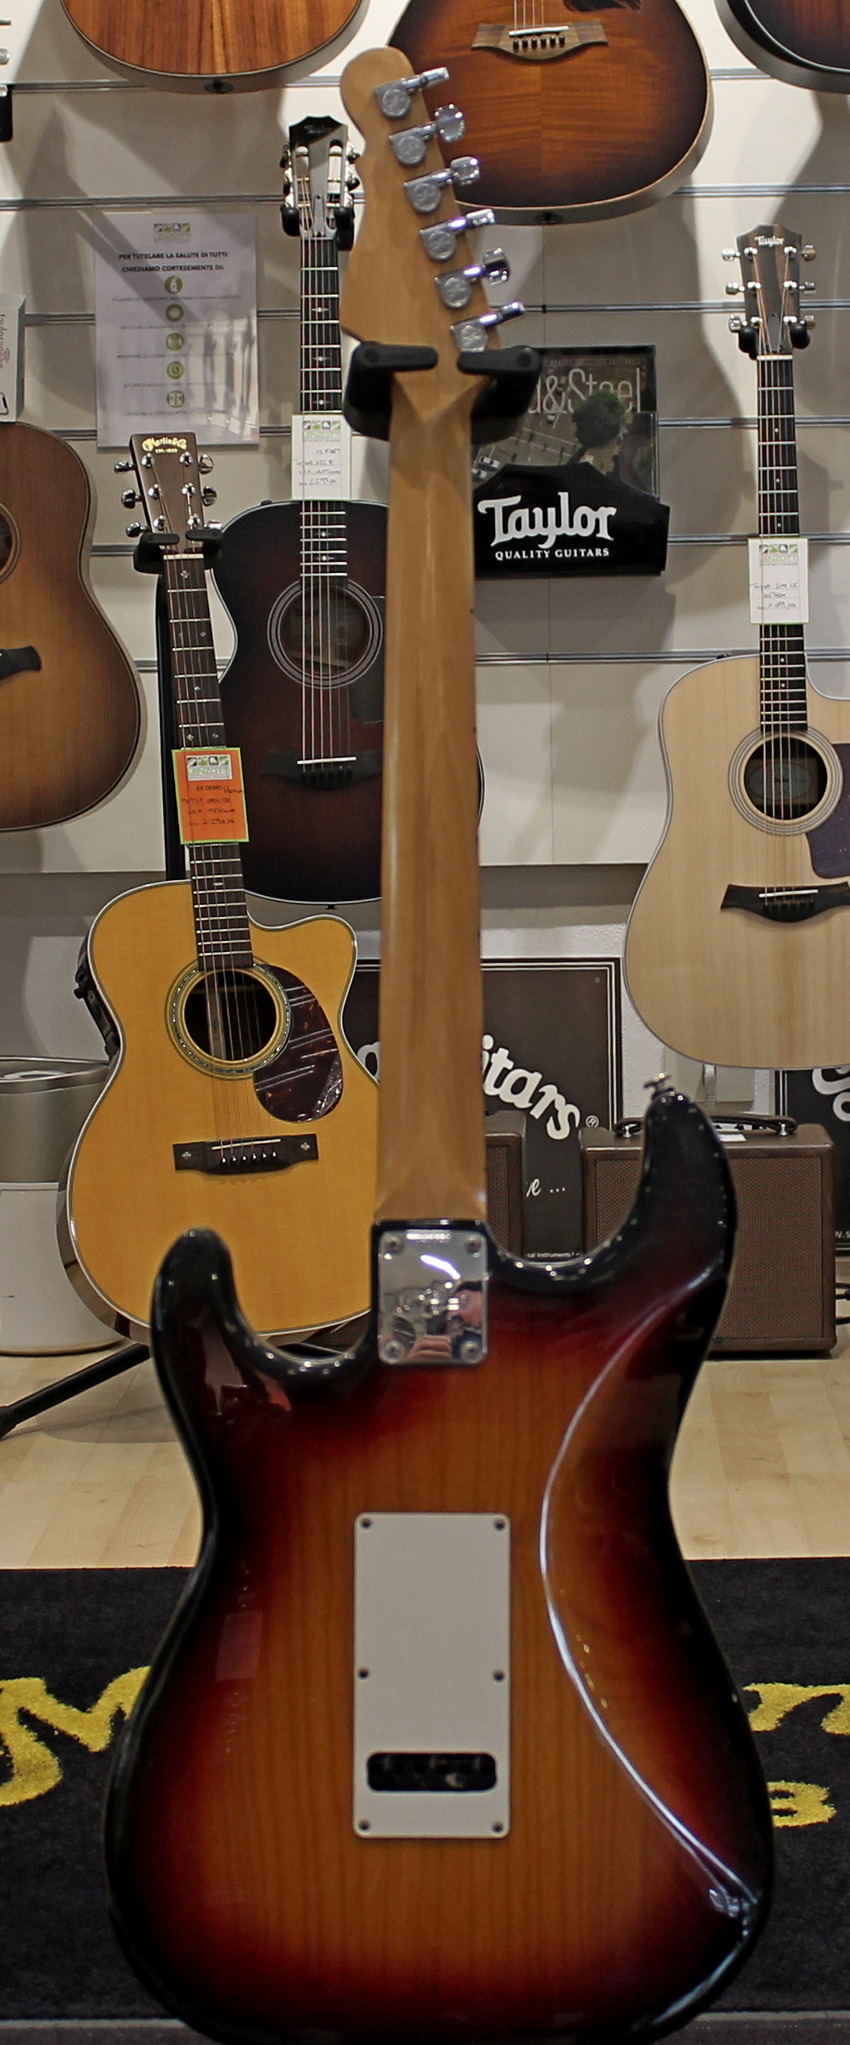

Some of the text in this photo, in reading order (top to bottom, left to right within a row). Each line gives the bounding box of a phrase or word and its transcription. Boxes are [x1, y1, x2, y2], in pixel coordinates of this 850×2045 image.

[754, 235, 784, 247] Taylor
[162, 264, 214, 272] CORTESEMENTE
[477, 491, 617, 549] Taylor
[495, 548, 610, 561] QUALITY GUITARS
